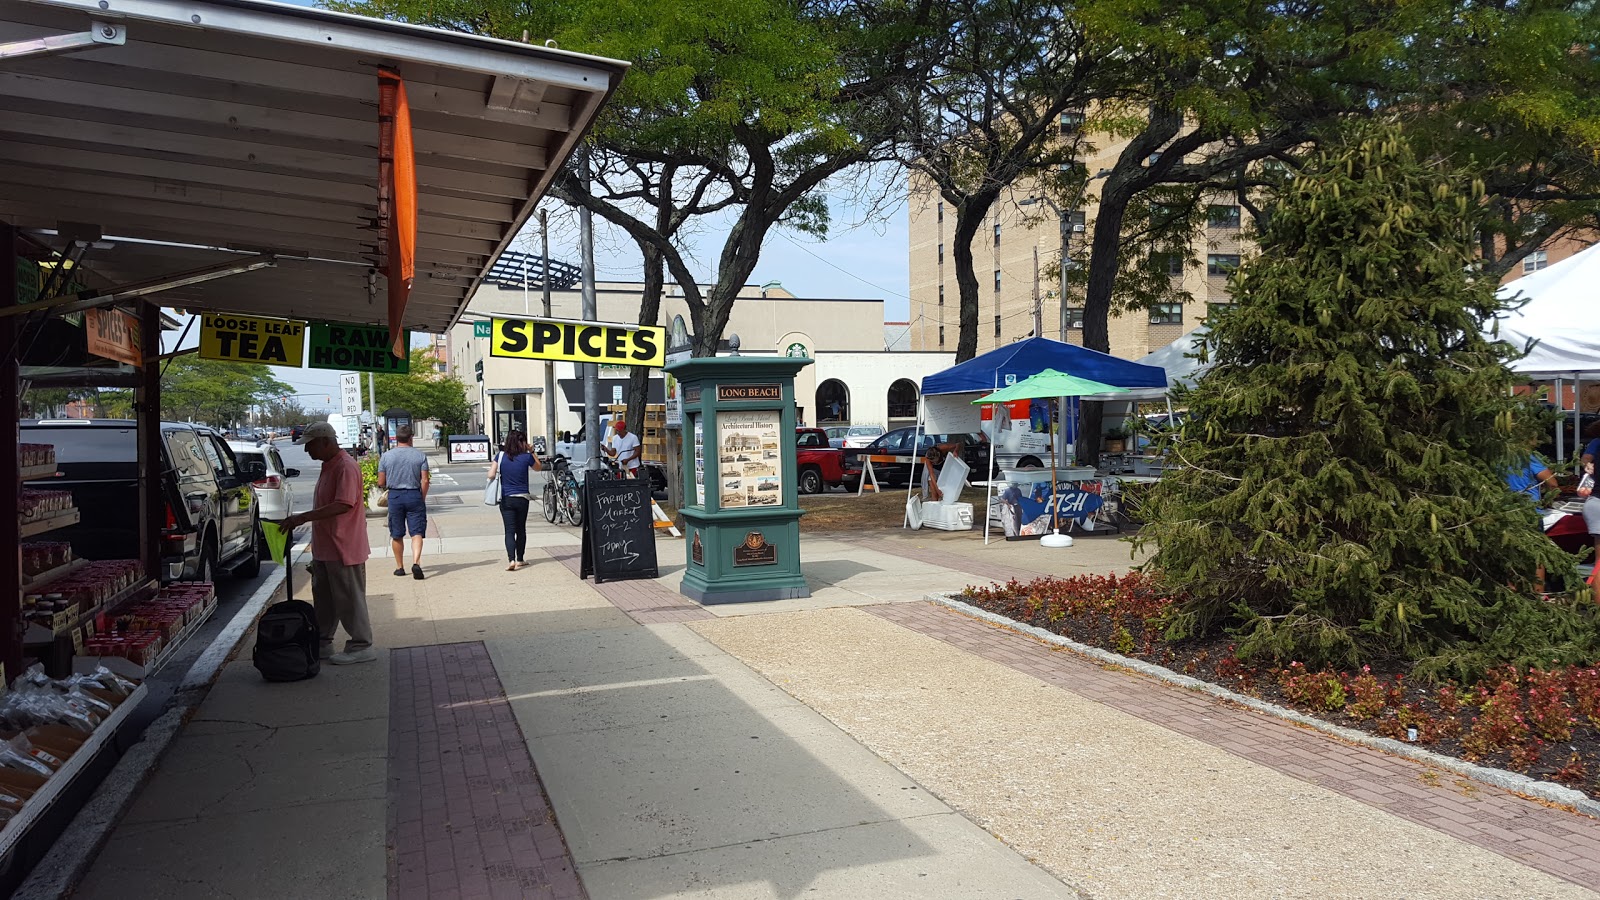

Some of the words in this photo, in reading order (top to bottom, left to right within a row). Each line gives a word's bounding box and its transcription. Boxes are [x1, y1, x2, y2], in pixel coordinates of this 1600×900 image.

[97, 309, 123, 345] SPICES
[204, 315, 258, 331] LOOSE
[264, 320, 301, 336] LEAF
[330, 326, 392, 347] RAW
[500, 319, 657, 361] SPICES
[216, 331, 287, 362] TEA
[315, 346, 400, 369] HONEY
[345, 376, 355, 386] NO
[344, 387, 357, 395] TURN
[347, 396, 355, 404] ON
[720, 388, 746, 397] LONG
[748, 387, 778, 397] BEACH
[347, 405, 357, 413] RED
[721, 421, 755, 430] Architectural
[756, 421, 774, 430] History
[596, 491, 640, 509] FARMERS
[1044, 492, 1089, 514] FISH
